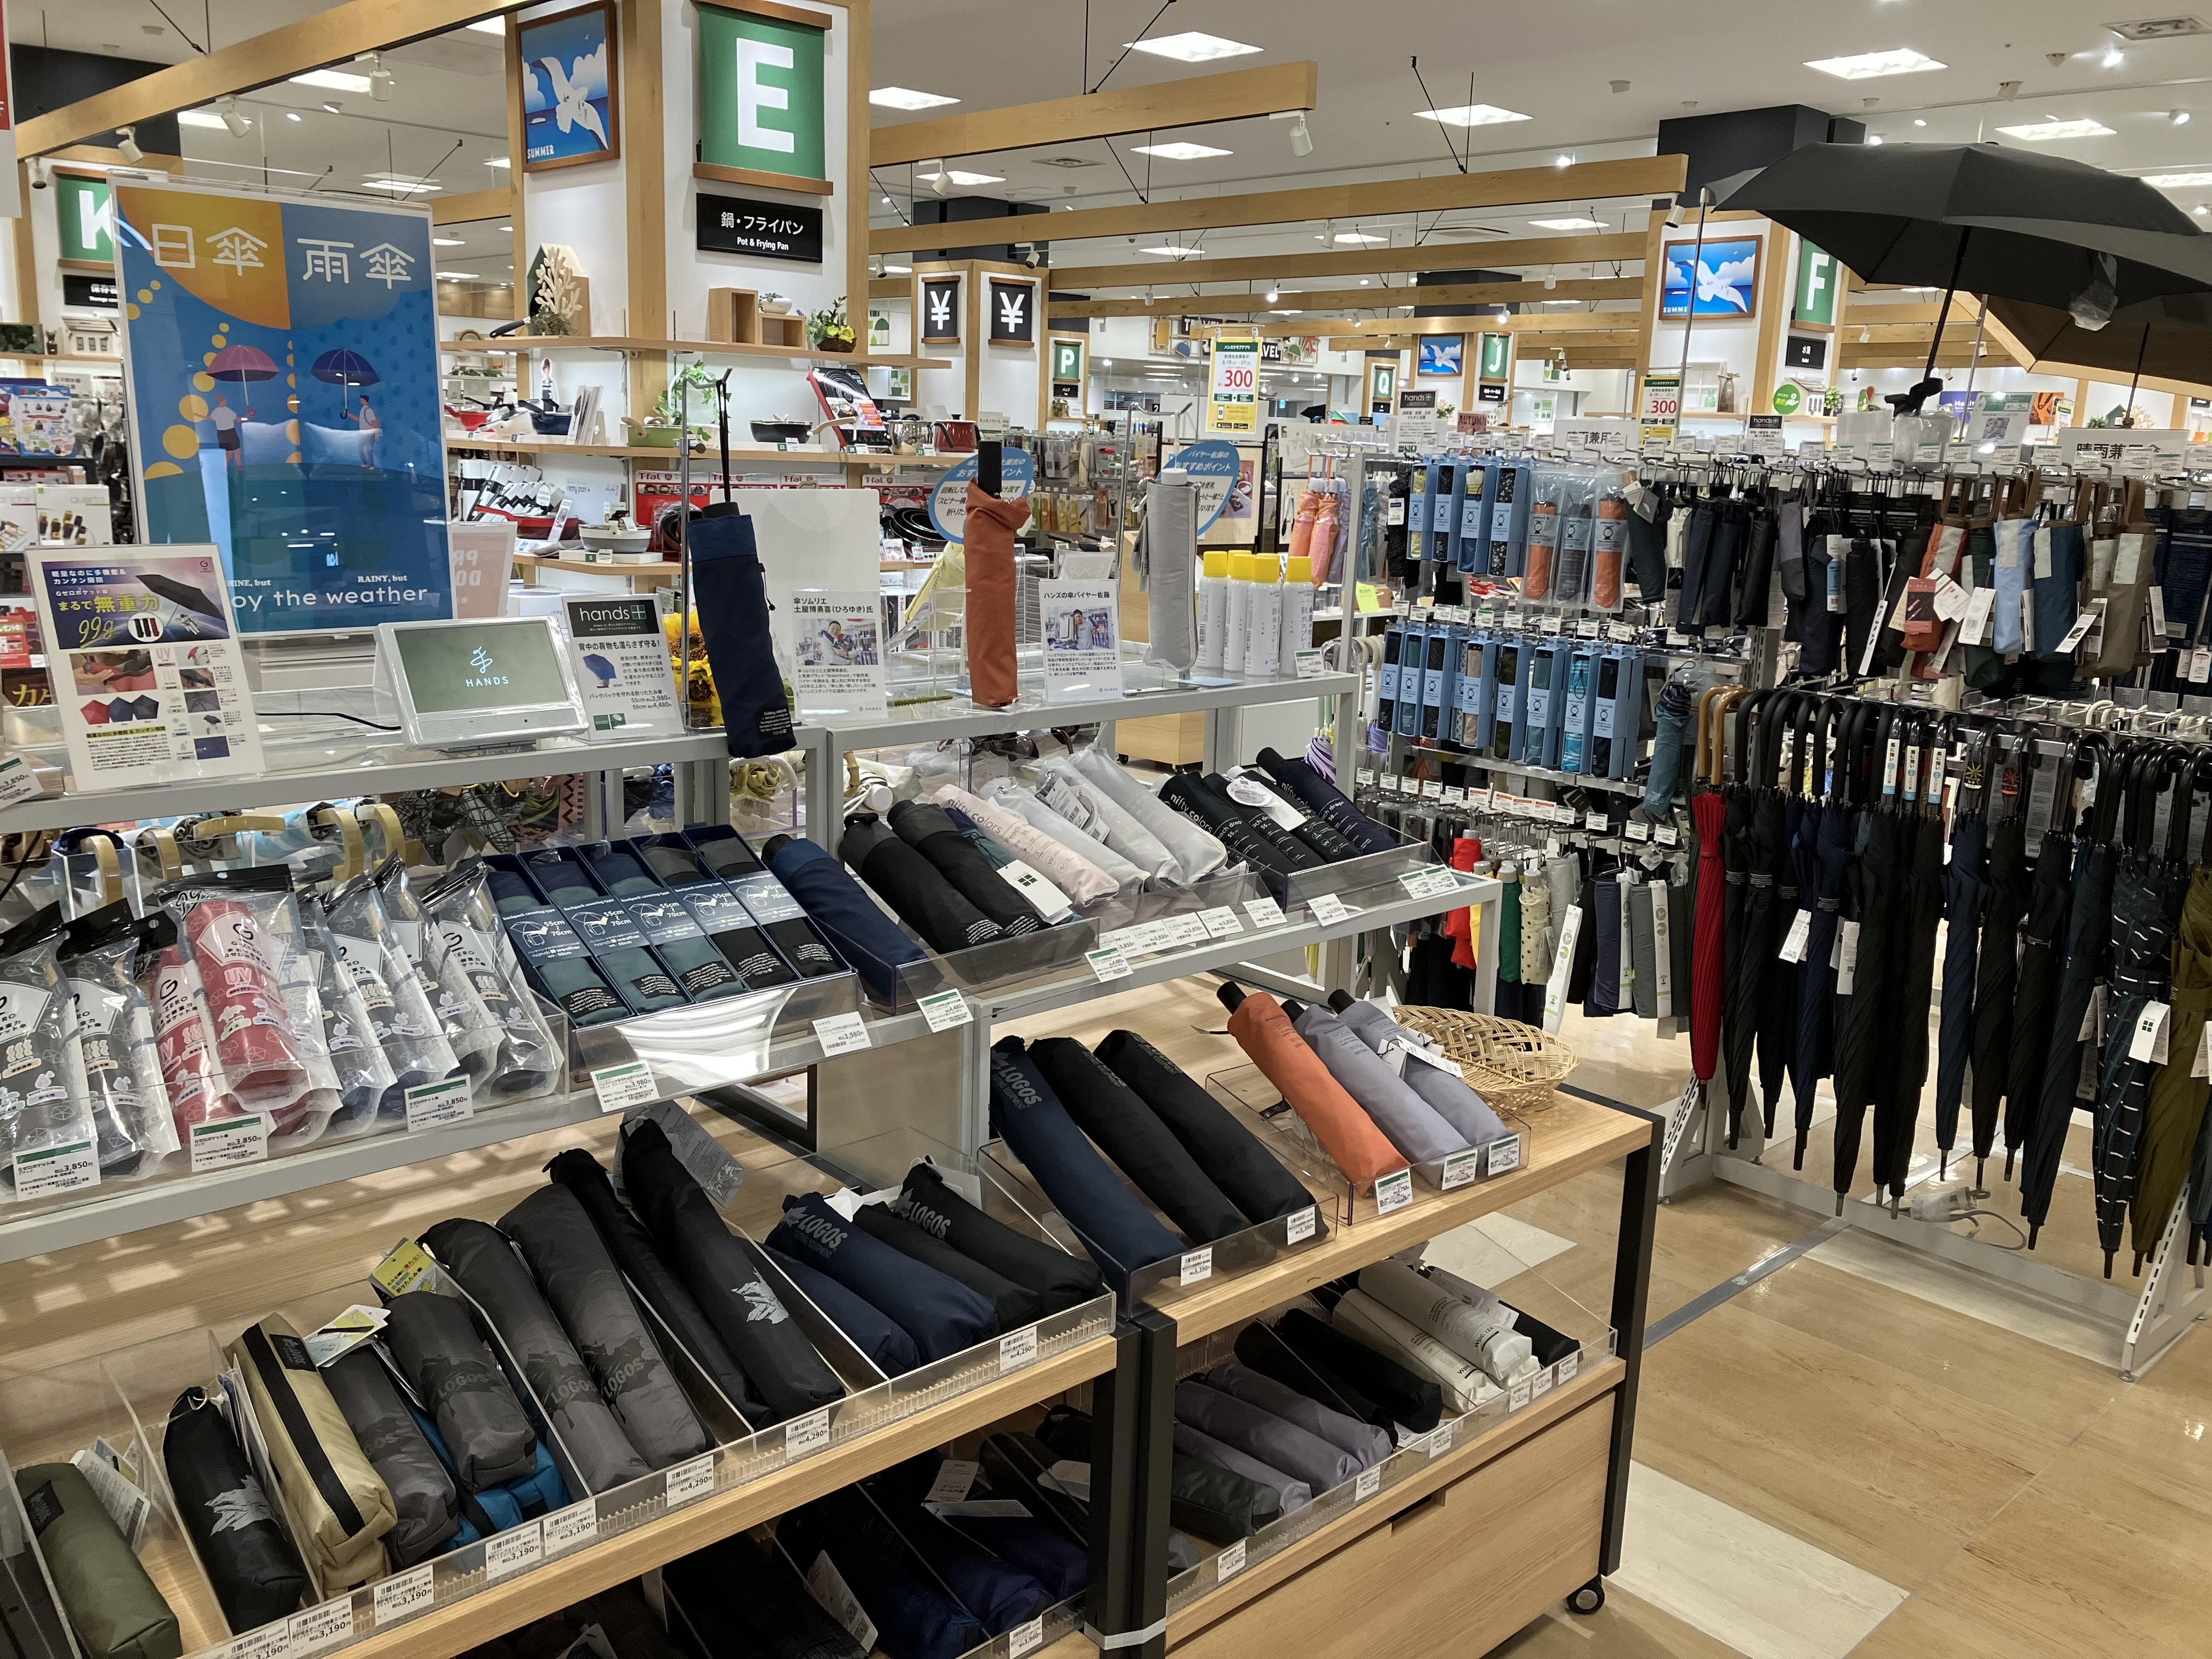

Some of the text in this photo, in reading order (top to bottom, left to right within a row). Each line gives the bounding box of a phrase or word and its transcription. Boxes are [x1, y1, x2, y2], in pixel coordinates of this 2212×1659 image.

[736, 37, 794, 153] E
[527, 144, 554, 159] SUMMER
[78, 190, 111, 250] K
[721, 211, 804, 235] 鍋・フライパン
[737, 236, 789, 252] Pot & Frying Pan
[152, 223, 415, 290] 日傘 雨傘
[1806, 252, 1830, 311] F
[930, 290, 951, 330] ¥
[999, 291, 1025, 333] ¥
[1060, 349, 1075, 374] P
[1488, 343, 1503, 373] J
[1224, 370, 1253, 387] 300
[1379, 372, 1389, 394] Q
[1650, 400, 1677, 414] 300
[53, 577, 104, 585] カンタン開閉
[227, 579, 252, 588] HINE,
[358, 575, 390, 584] RAINY,
[58, 593, 160, 614] まるで無重力
[232, 586, 427, 613] oy the weather
[1043, 591, 1110, 599] ハンズの傘バイヤー佐藤
[579, 606, 630, 622] hands
[156, 647, 171, 659] UV
[465, 675, 509, 687] HANDS
[589, 690, 663, 699] バックパックを守れる折りたたみ傘
[947, 798, 1003, 834] nifty colors
[1170, 793, 1214, 834] nifty colors
[224, 967, 252, 986] UV
[1000, 1065, 1042, 1106] LOGOS
[798, 1214, 848, 1250] LOGOS
[909, 1205, 952, 1240] LOGOS
[439, 1373, 491, 1397] LOGOS
[603, 1358, 645, 1399] LOGOS
